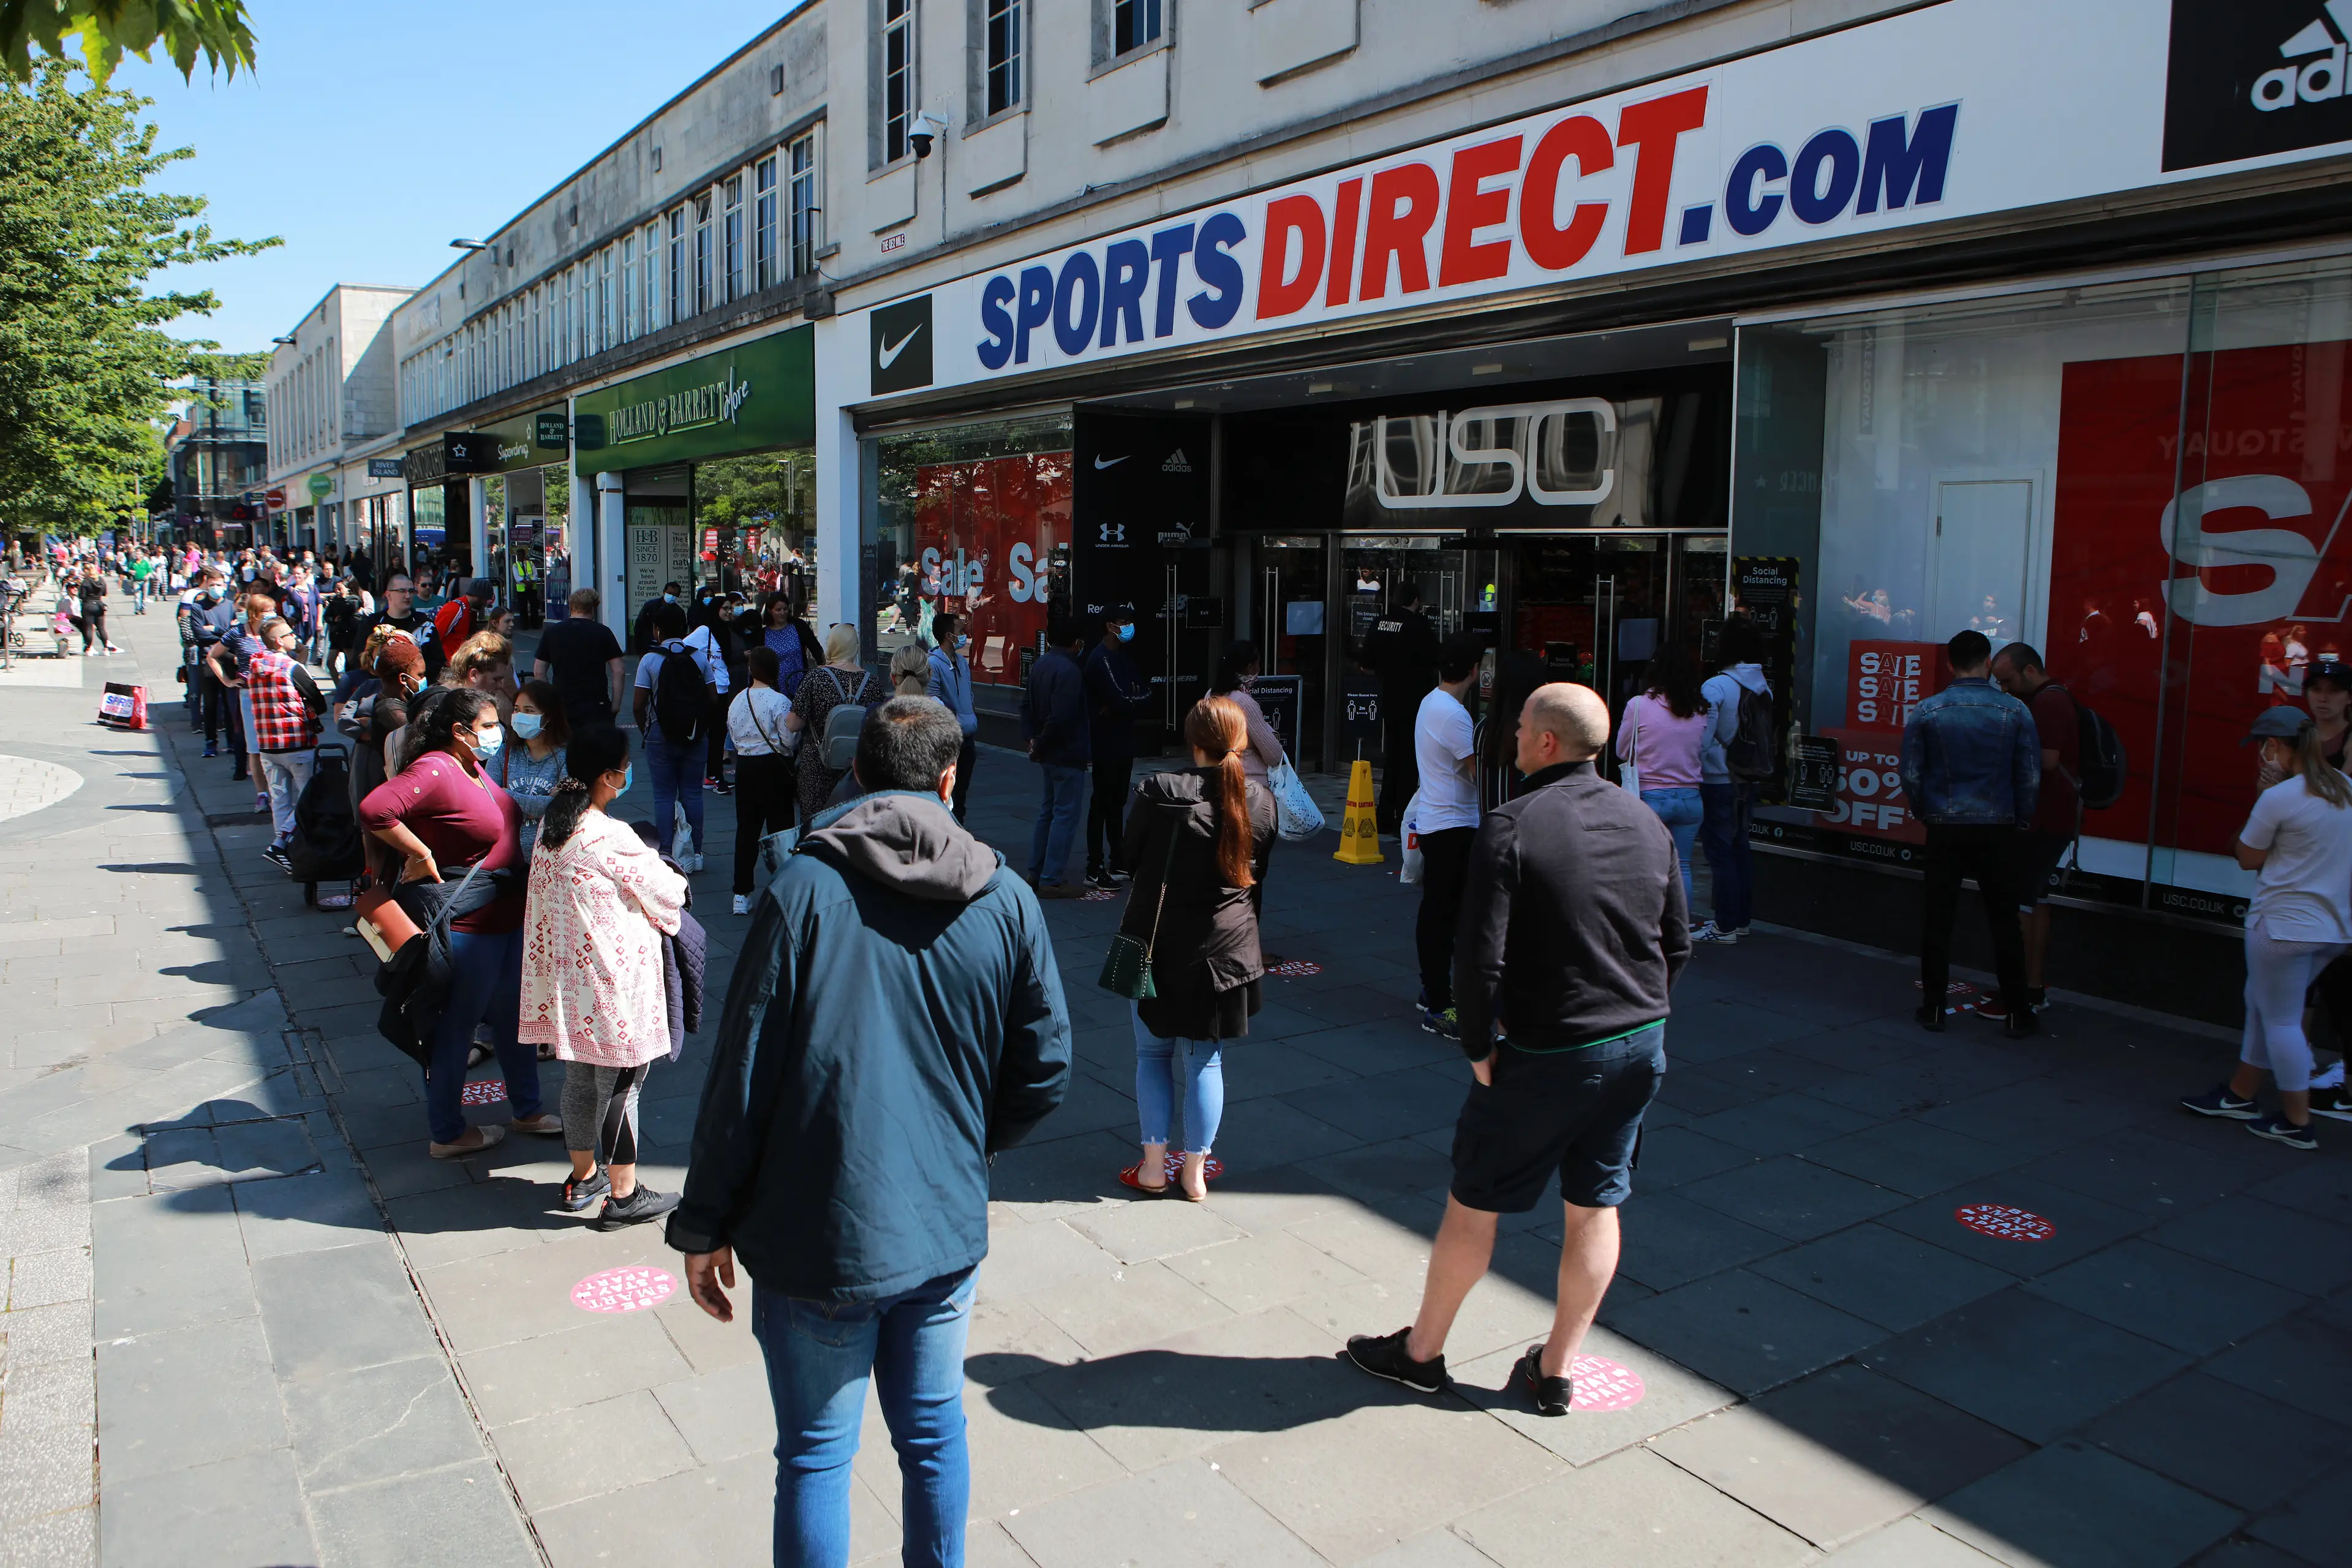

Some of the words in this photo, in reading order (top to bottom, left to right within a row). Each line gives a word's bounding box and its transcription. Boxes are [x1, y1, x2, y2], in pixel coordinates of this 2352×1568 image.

[609, 401, 656, 445] HOLLAND
[658, 398, 669, 435] &
[669, 381, 728, 426] BARRETT
[498, 442, 529, 462] Superdrug
[1376, 397, 1616, 509] USC
[1162, 464, 1192, 473] adidas
[635, 530, 658, 543] H&B
[636, 554, 657, 562] 1870
[921, 547, 984, 597] Sale
[1752, 567, 1779, 575] Social
[1743, 576, 1788, 586] Distancing
[1378, 620, 1403, 633] SECURITY
[1860, 652, 1921, 679] SALE
[1858, 676, 1920, 703] SALE
[1845, 750, 1871, 763] UP
[1874, 753, 1899, 767] TO
[1850, 840, 1896, 858] USC.CO.UK
[2163, 892, 2226, 914] USC.CO.UK
[1977, 1205, 2052, 1235] SMART.
[1978, 1214, 2027, 1231] STAY
[2007, 1208, 2037, 1219] BE
[1962, 1216, 2023, 1241] APART.
[579, 1270, 650, 1291] APART.
[598, 1278, 650, 1296] STAY
[582, 1283, 670, 1308] SMART.
[623, 1298, 653, 1311] BE
[1575, 1379, 1640, 1406] APART.
